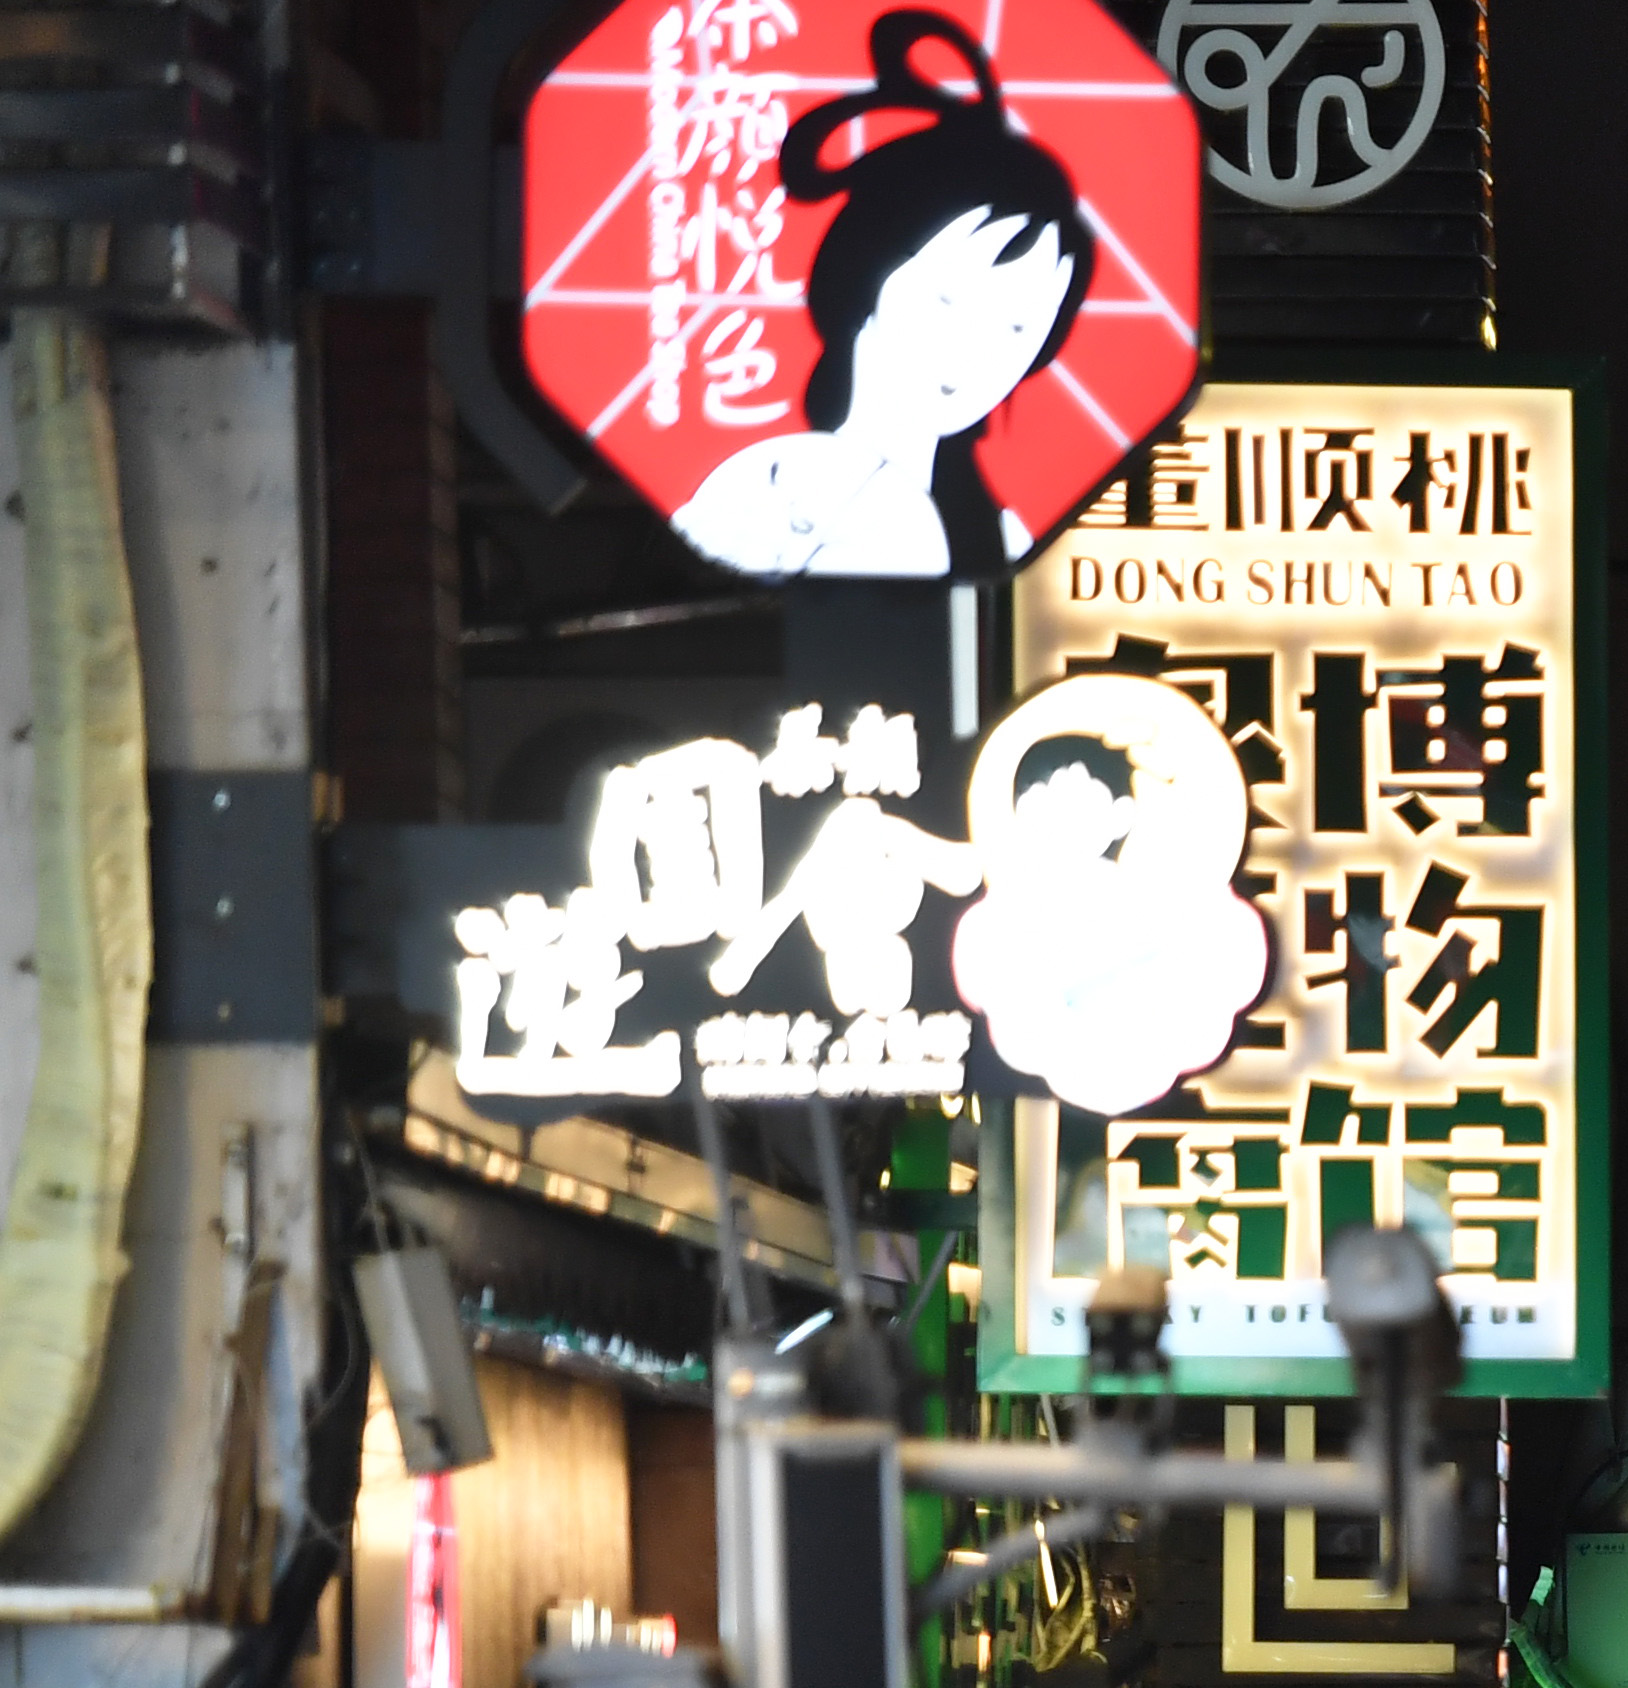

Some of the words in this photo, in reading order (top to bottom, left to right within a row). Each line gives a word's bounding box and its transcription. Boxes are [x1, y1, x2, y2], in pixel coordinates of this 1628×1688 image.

[1067, 556, 1226, 606] DONG
[1246, 556, 1395, 606] SHUN
[1414, 556, 1525, 606] TAO
